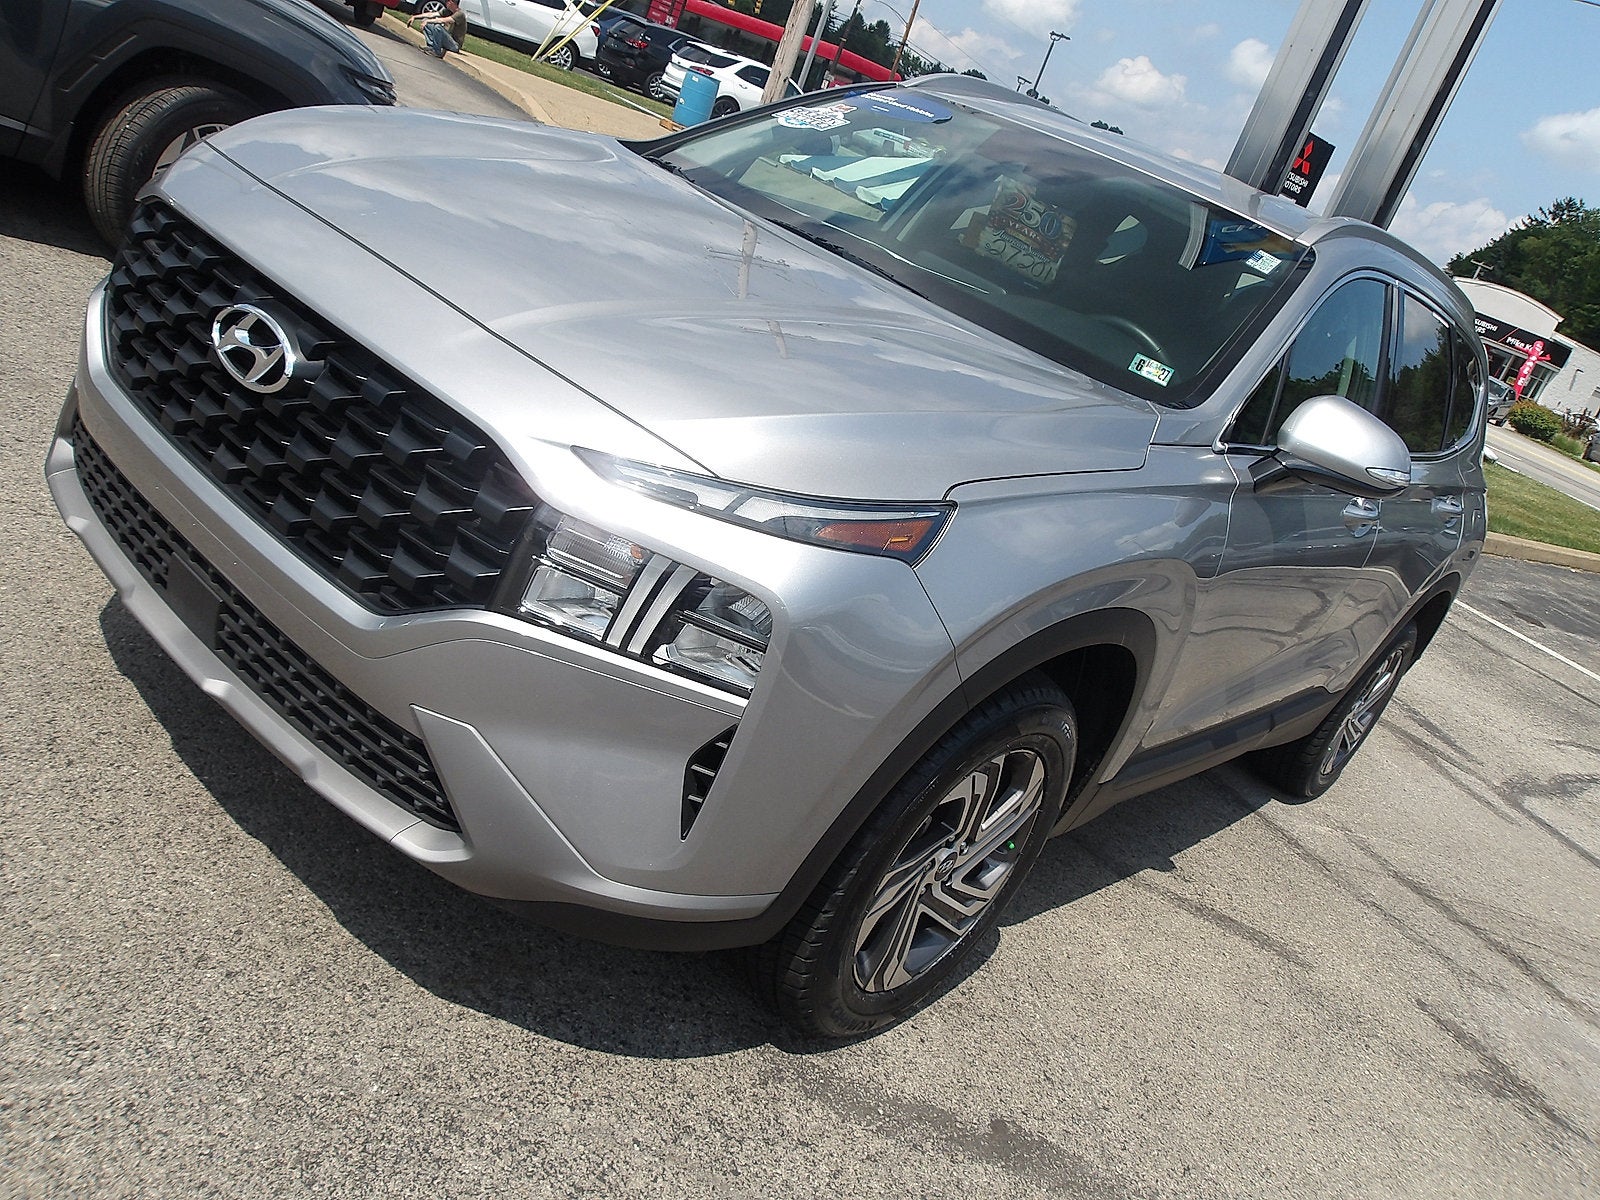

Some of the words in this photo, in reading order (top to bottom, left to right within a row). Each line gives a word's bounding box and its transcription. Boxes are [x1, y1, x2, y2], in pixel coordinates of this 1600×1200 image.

[1000, 191, 1063, 240] 250
[1505, 336, 1525, 348] Mike
[1135, 358, 1146, 372] 6
[1157, 367, 1171, 382] 27
